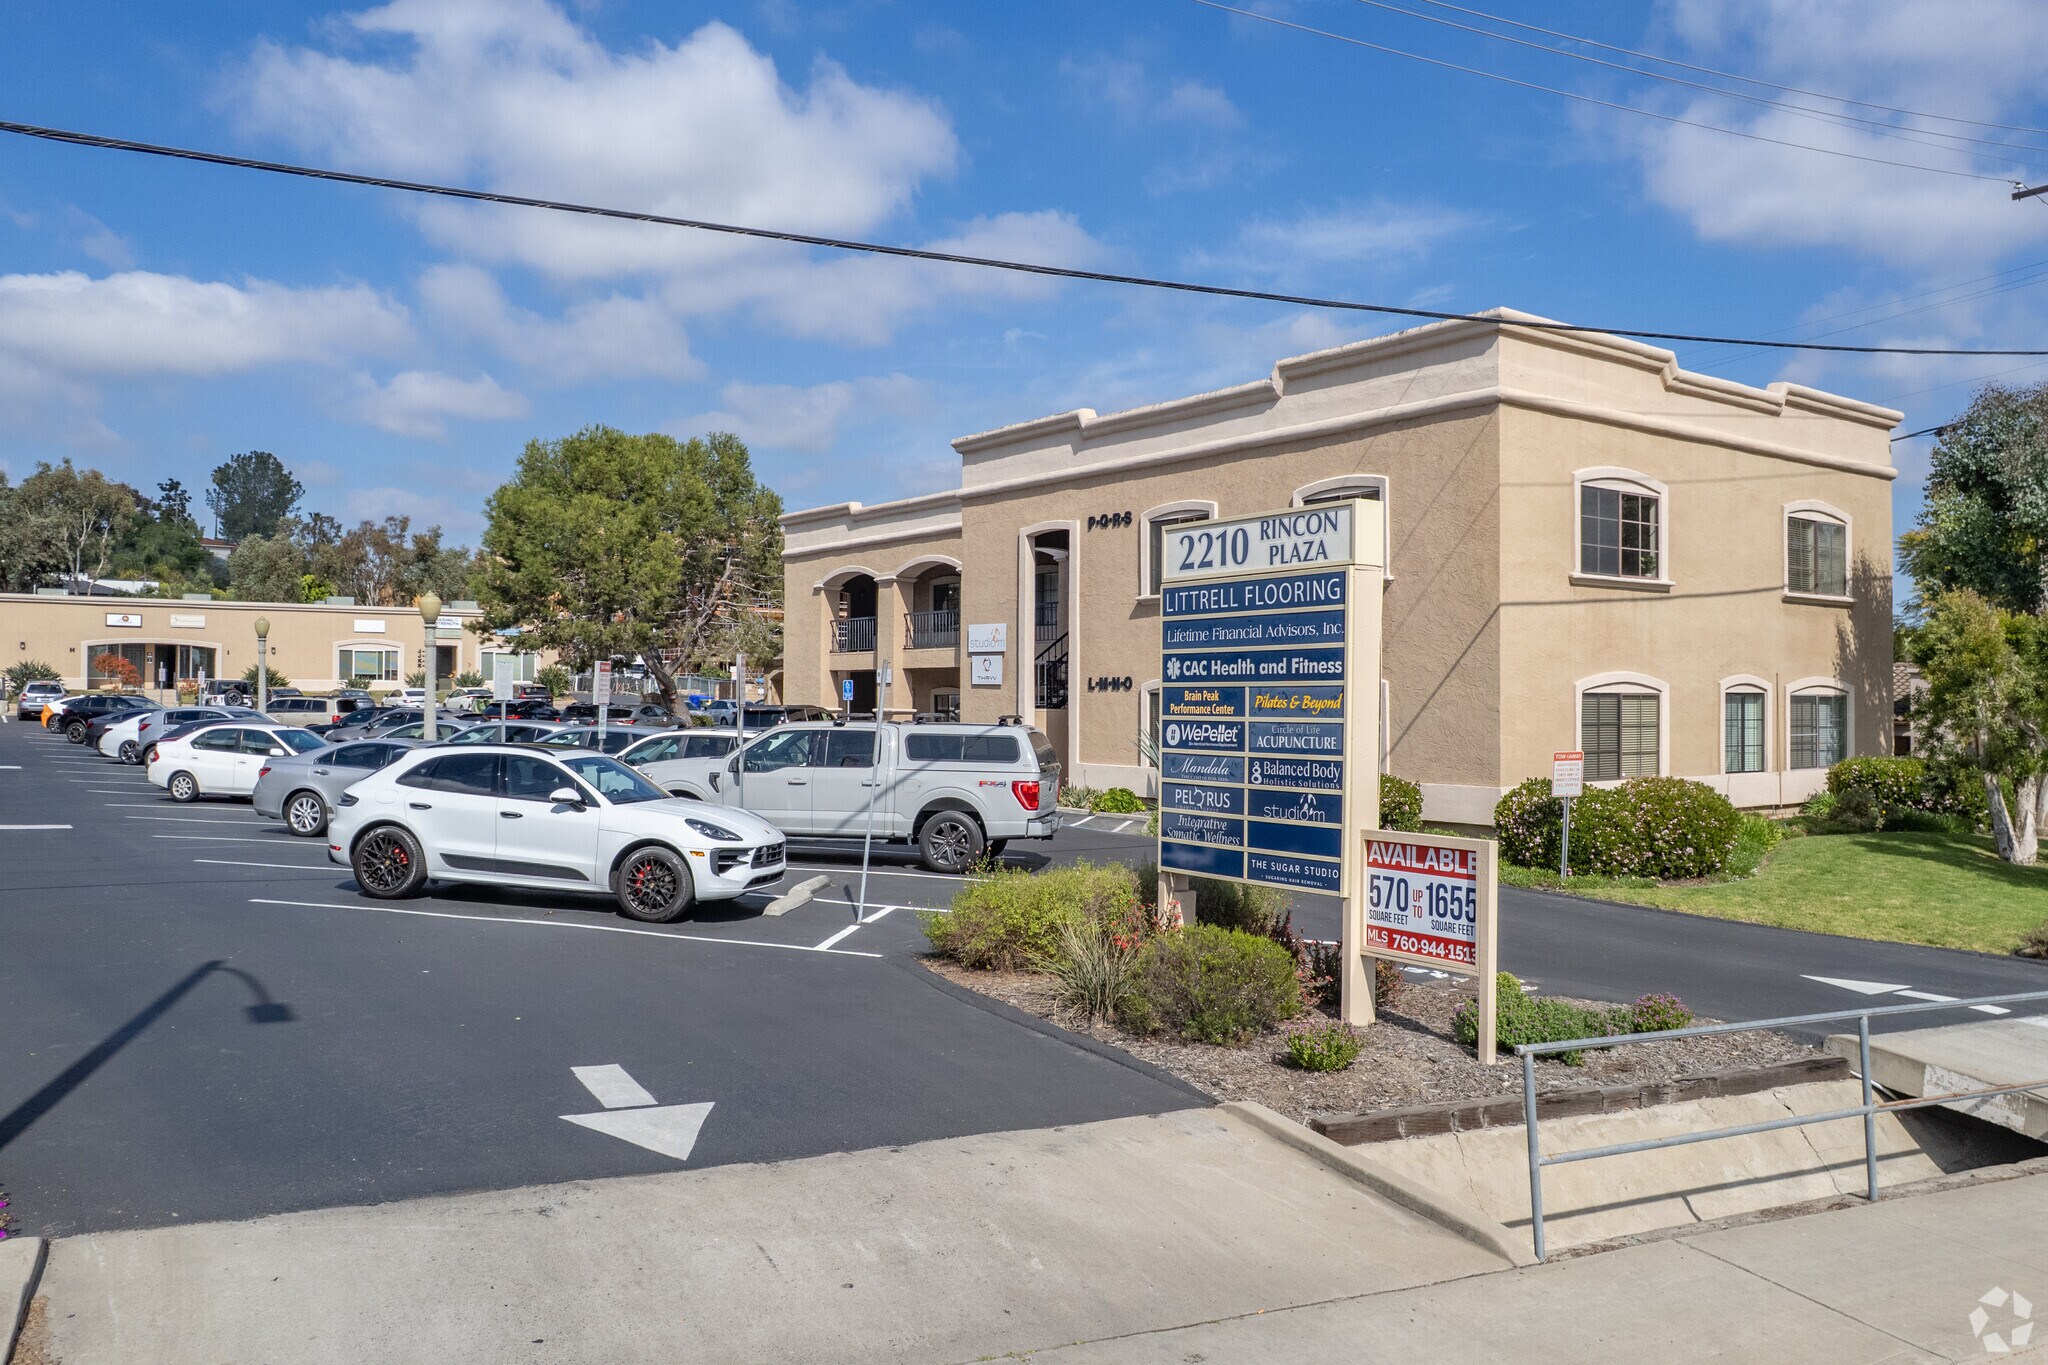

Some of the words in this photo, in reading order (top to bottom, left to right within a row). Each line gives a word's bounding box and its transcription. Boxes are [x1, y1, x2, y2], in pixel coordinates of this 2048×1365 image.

[1260, 510, 1338, 541] RINCON
[1180, 528, 1249, 570] 2210
[1269, 539, 1328, 566] PLAZA
[1166, 588, 1238, 612] LITTRELL
[1246, 578, 1340, 606] FLOORING
[1168, 629, 1210, 642] Lifetime
[1212, 624, 1262, 640] Financial
[1266, 624, 1318, 638] Advisors,
[1323, 622, 1344, 634] Inc.
[1183, 660, 1208, 676] CAC
[1211, 658, 1255, 676] Health
[1259, 658, 1286, 674] and
[1292, 658, 1342, 674] Fitness
[1184, 690, 1202, 700] Brain
[1203, 690, 1219, 700] Peak
[1255, 693, 1288, 708] Pilates
[1290, 696, 1300, 708] &
[1302, 693, 1343, 714] Beyond
[1170, 704, 1211, 714] Performance
[1212, 704, 1234, 714] Center
[1272, 725, 1294, 734] Circle
[1296, 725, 1304, 734] of
[1306, 726, 1320, 734] Life
[1256, 736, 1336, 750] ACUPUNCTURE
[1170, 756, 1230, 774] Mandala
[1264, 760, 1310, 776] Balanced
[1312, 762, 1340, 782] Body
[1264, 778, 1296, 786] Holistic
[1298, 780, 1340, 789] Solutions
[1178, 814, 1227, 831] Integrative
[1166, 826, 1200, 840] Somatic
[1202, 830, 1240, 846] Wellness
[1368, 842, 1476, 876] AVAILABLE
[1252, 860, 1267, 870] THE
[1270, 862, 1300, 874] SUGAR
[1304, 866, 1339, 878] STUDIO
[1370, 874, 1408, 912] 570
[1412, 889, 1423, 902] UP
[1413, 904, 1422, 918] TO
[1426, 882, 1476, 923] 1655
[1368, 910, 1392, 923] SQUARE
[1393, 912, 1408, 926] FEET
[1368, 928, 1388, 943] MLS
[1430, 919, 1456, 934] SQUARE
[1458, 923, 1474, 937] FEET
